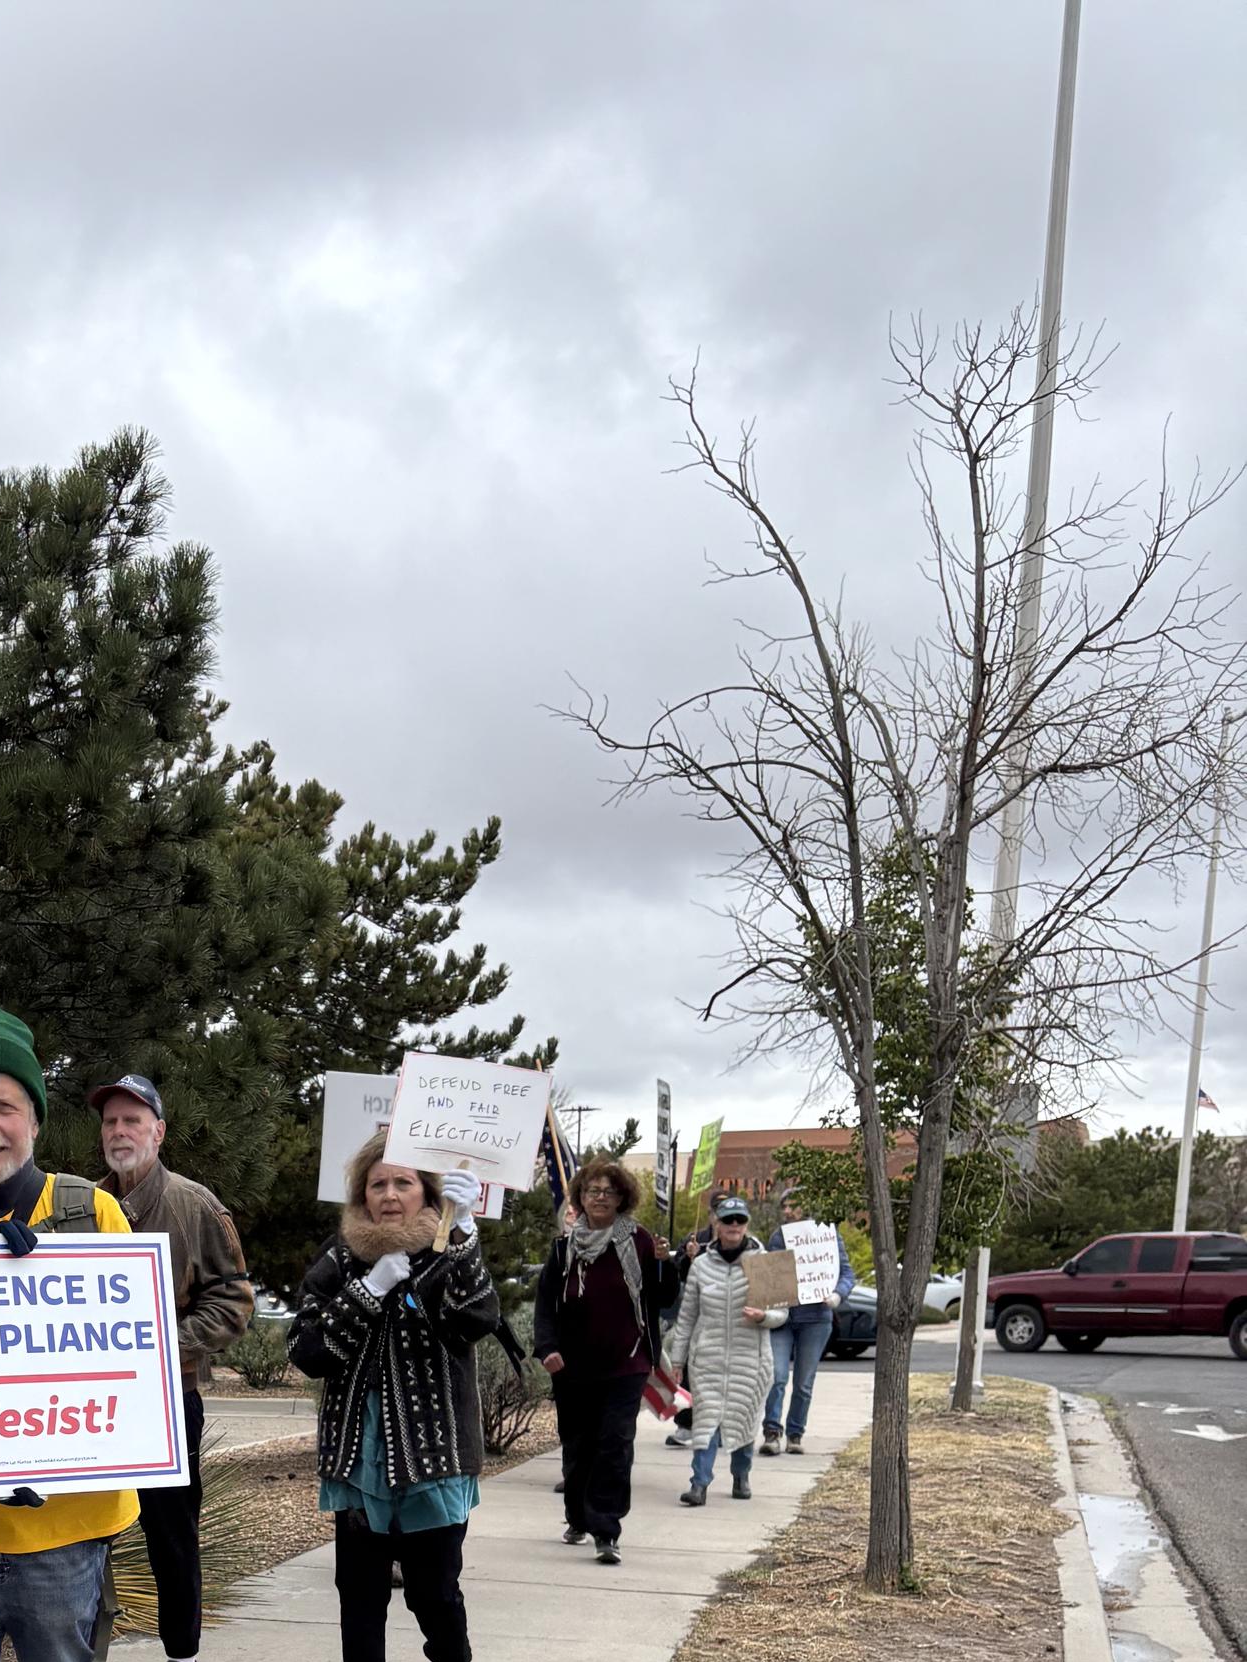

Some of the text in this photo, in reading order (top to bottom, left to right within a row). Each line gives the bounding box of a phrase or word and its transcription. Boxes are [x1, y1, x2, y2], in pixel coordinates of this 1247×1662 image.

[418, 1076, 532, 1098] DEFEND FREE
[427, 1096, 500, 1115] AND FAIR
[408, 1119, 522, 1150] ELECTIONS!
[97, 1273, 131, 1305] IS
